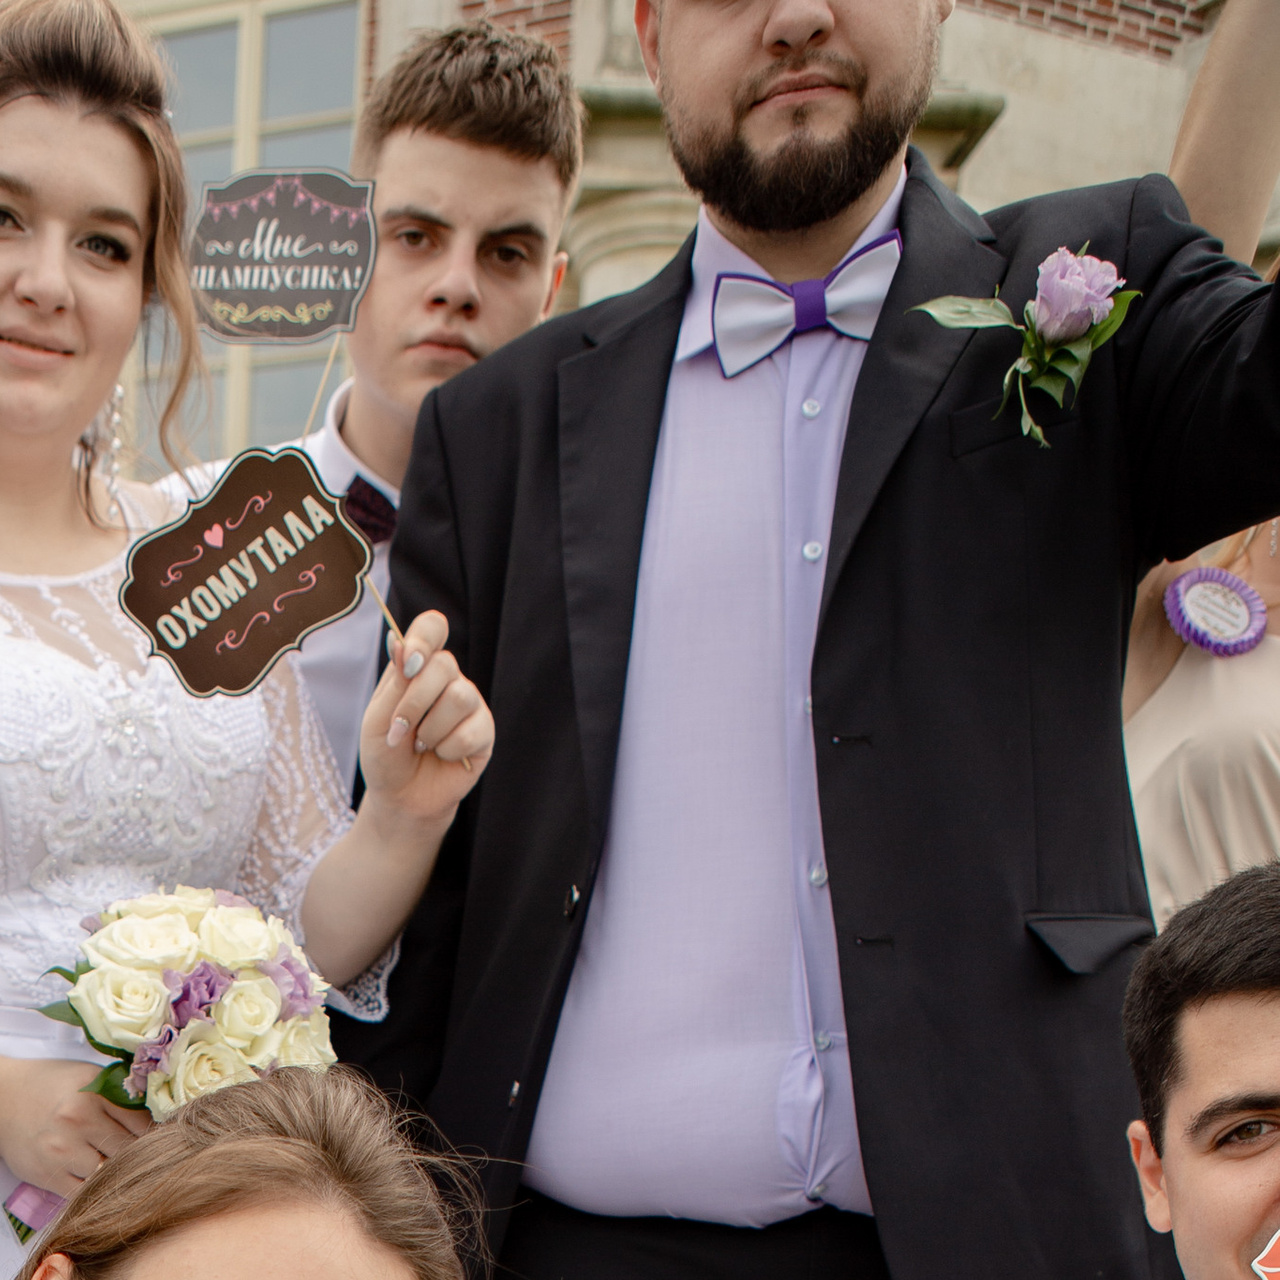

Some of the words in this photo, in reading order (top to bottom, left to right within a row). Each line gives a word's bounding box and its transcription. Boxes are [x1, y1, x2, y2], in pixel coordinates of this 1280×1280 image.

[238, 217, 324, 263] Мне
[191, 264, 362, 293] ШАМПУСИКА!
[156, 494, 335, 650] ОХОМУТАЛА
